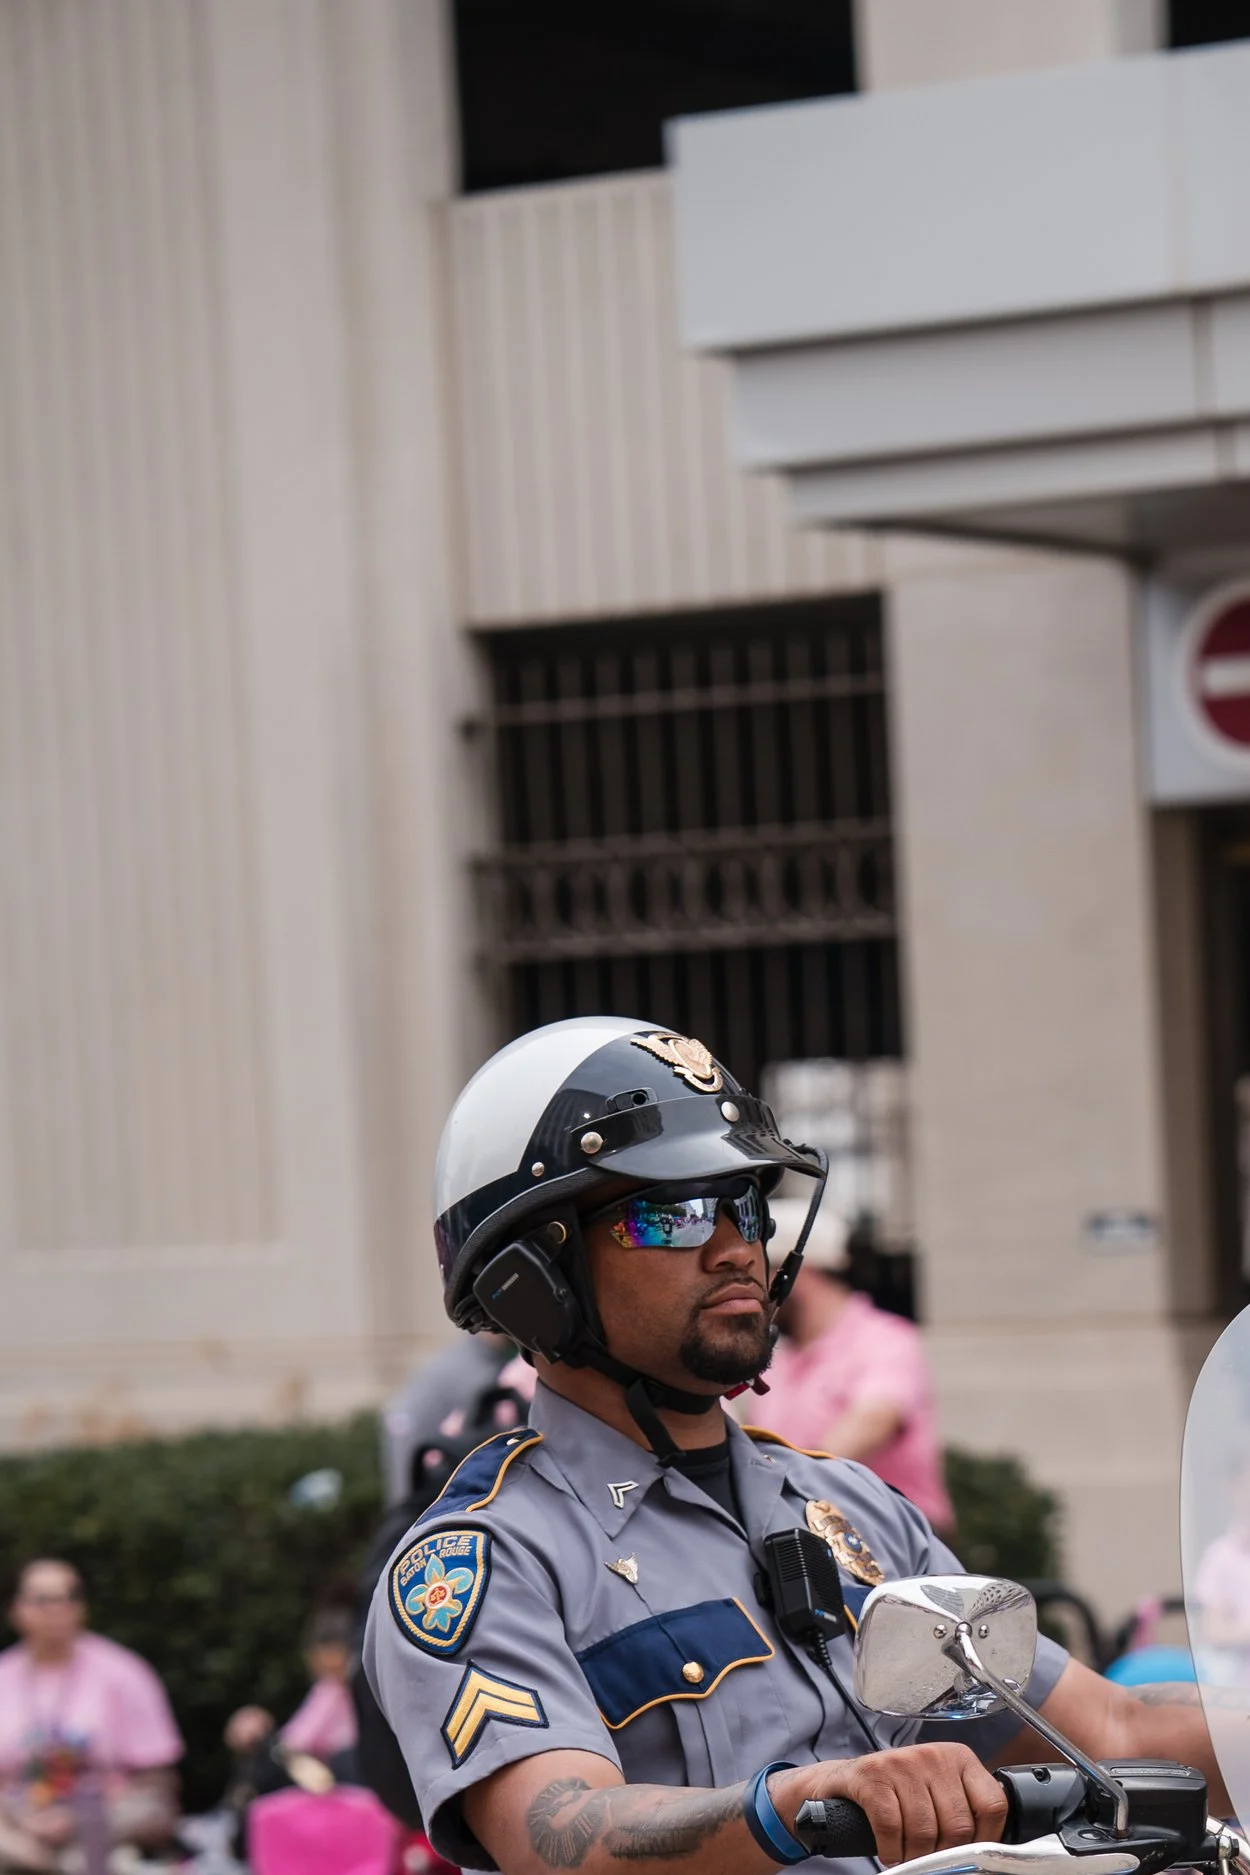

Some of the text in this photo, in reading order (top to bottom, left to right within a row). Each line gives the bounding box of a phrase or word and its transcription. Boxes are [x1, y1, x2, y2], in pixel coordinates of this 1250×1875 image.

[399, 1536, 473, 1576] POLICE
[400, 1546, 472, 1586] BATON ROUGE
